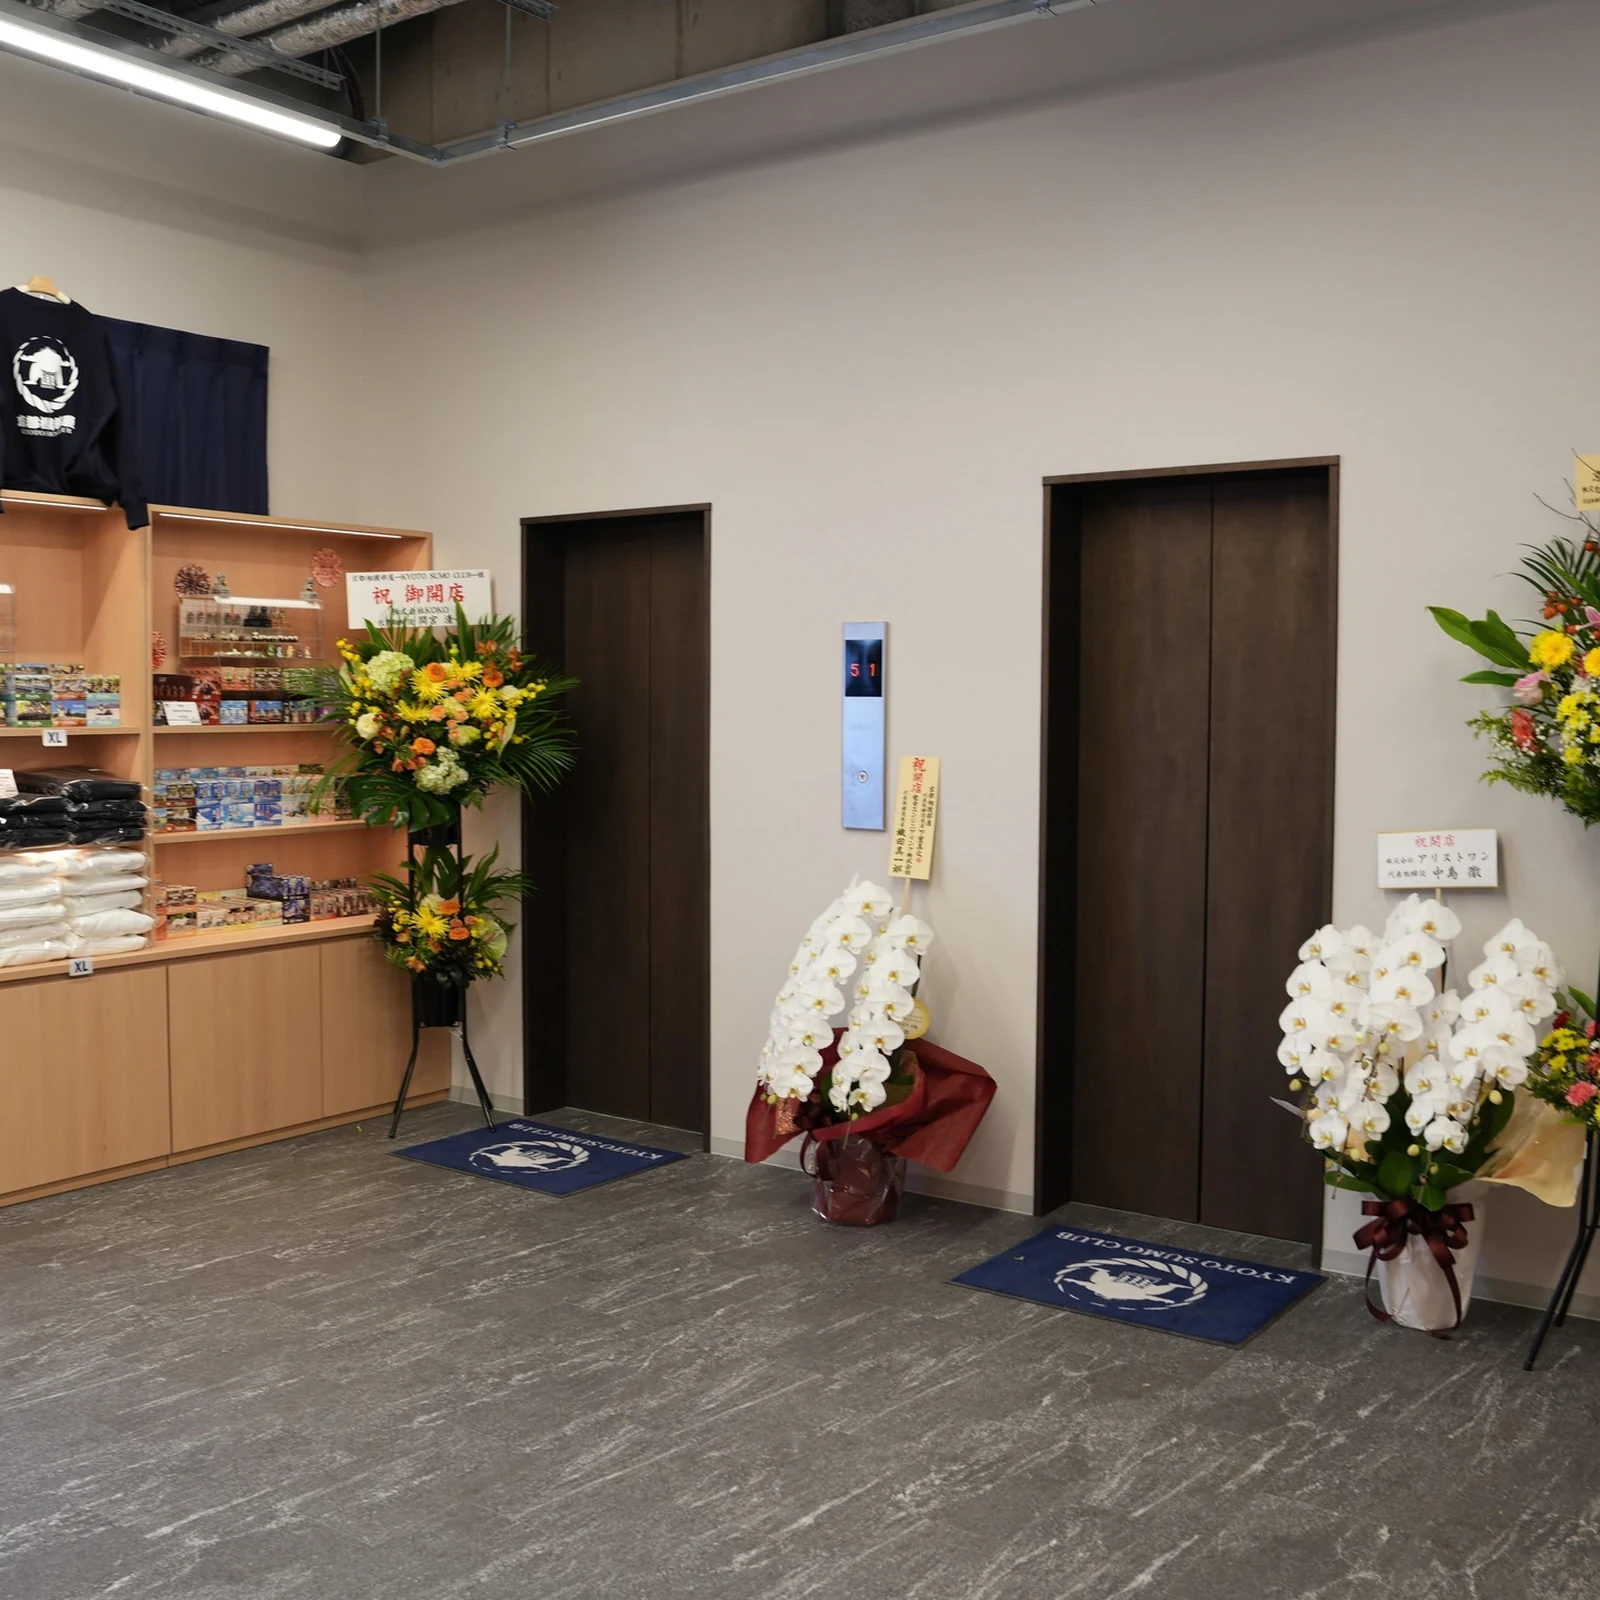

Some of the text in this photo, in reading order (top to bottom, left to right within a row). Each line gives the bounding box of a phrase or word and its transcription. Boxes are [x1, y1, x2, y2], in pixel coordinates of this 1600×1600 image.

[372, 582, 465, 604] 祝 御開店
[850, 662, 876, 677] 5 1
[47, 731, 62, 743] XL
[74, 960, 89, 973] XL
[551, 1132, 600, 1147] SUMO
[600, 1143, 664, 1160] KYOTO
[1056, 1231, 1298, 1285] KYOTO SUMO CLUB
